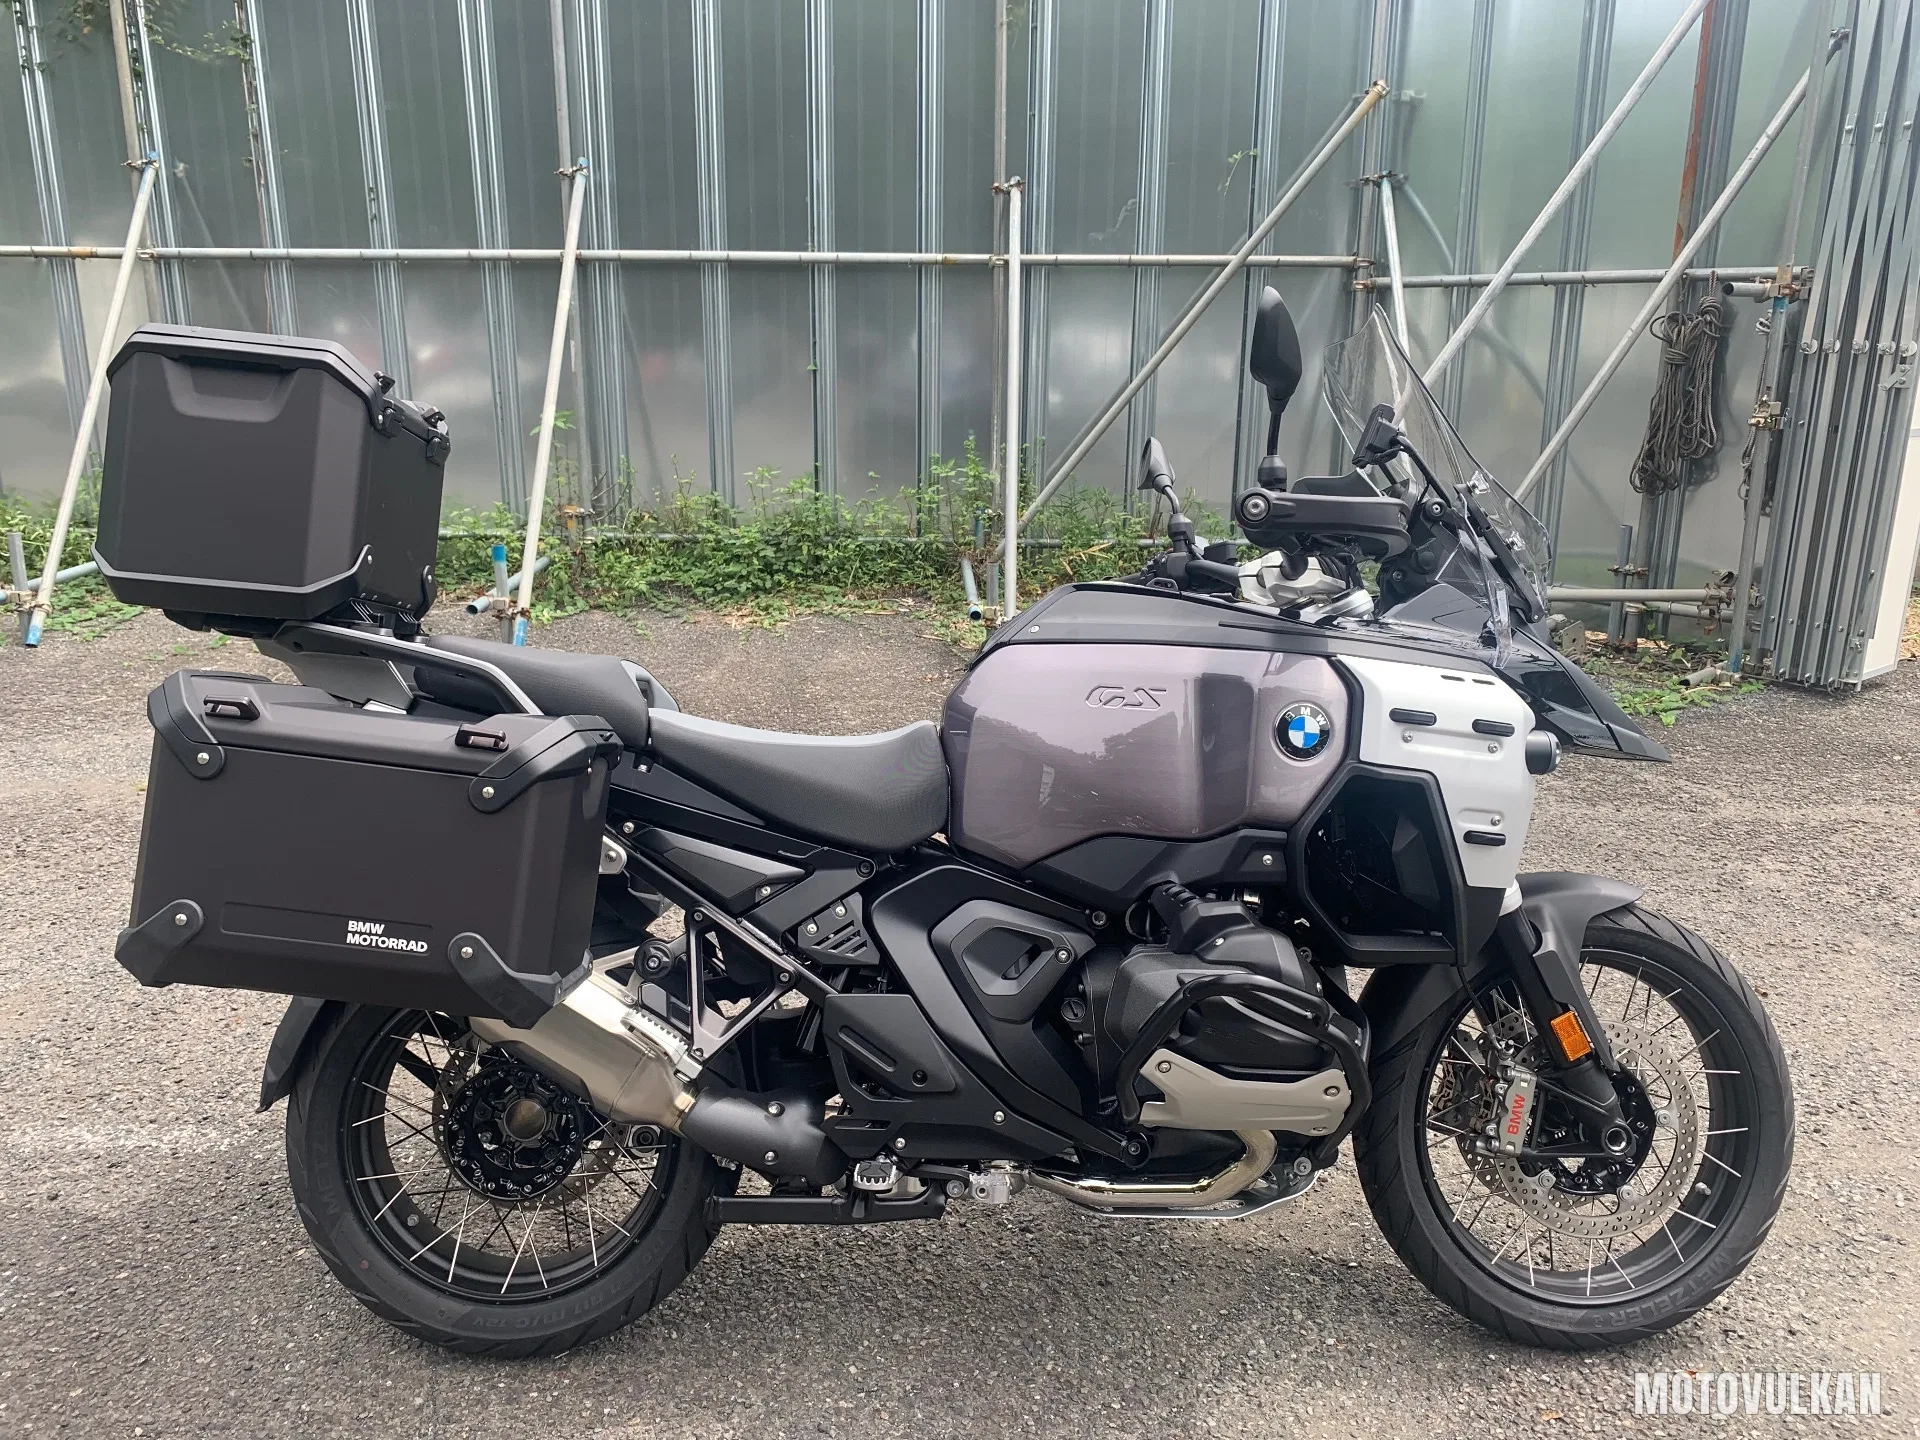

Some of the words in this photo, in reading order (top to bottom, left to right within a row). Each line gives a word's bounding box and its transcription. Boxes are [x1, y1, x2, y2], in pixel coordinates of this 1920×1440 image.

[1084, 684, 1167, 711] GS
[347, 920, 385, 935] BMW
[346, 932, 428, 953] MOTORRAD
[1507, 1093, 1526, 1136] BMW
[1608, 1253, 1733, 1328] METZELER
